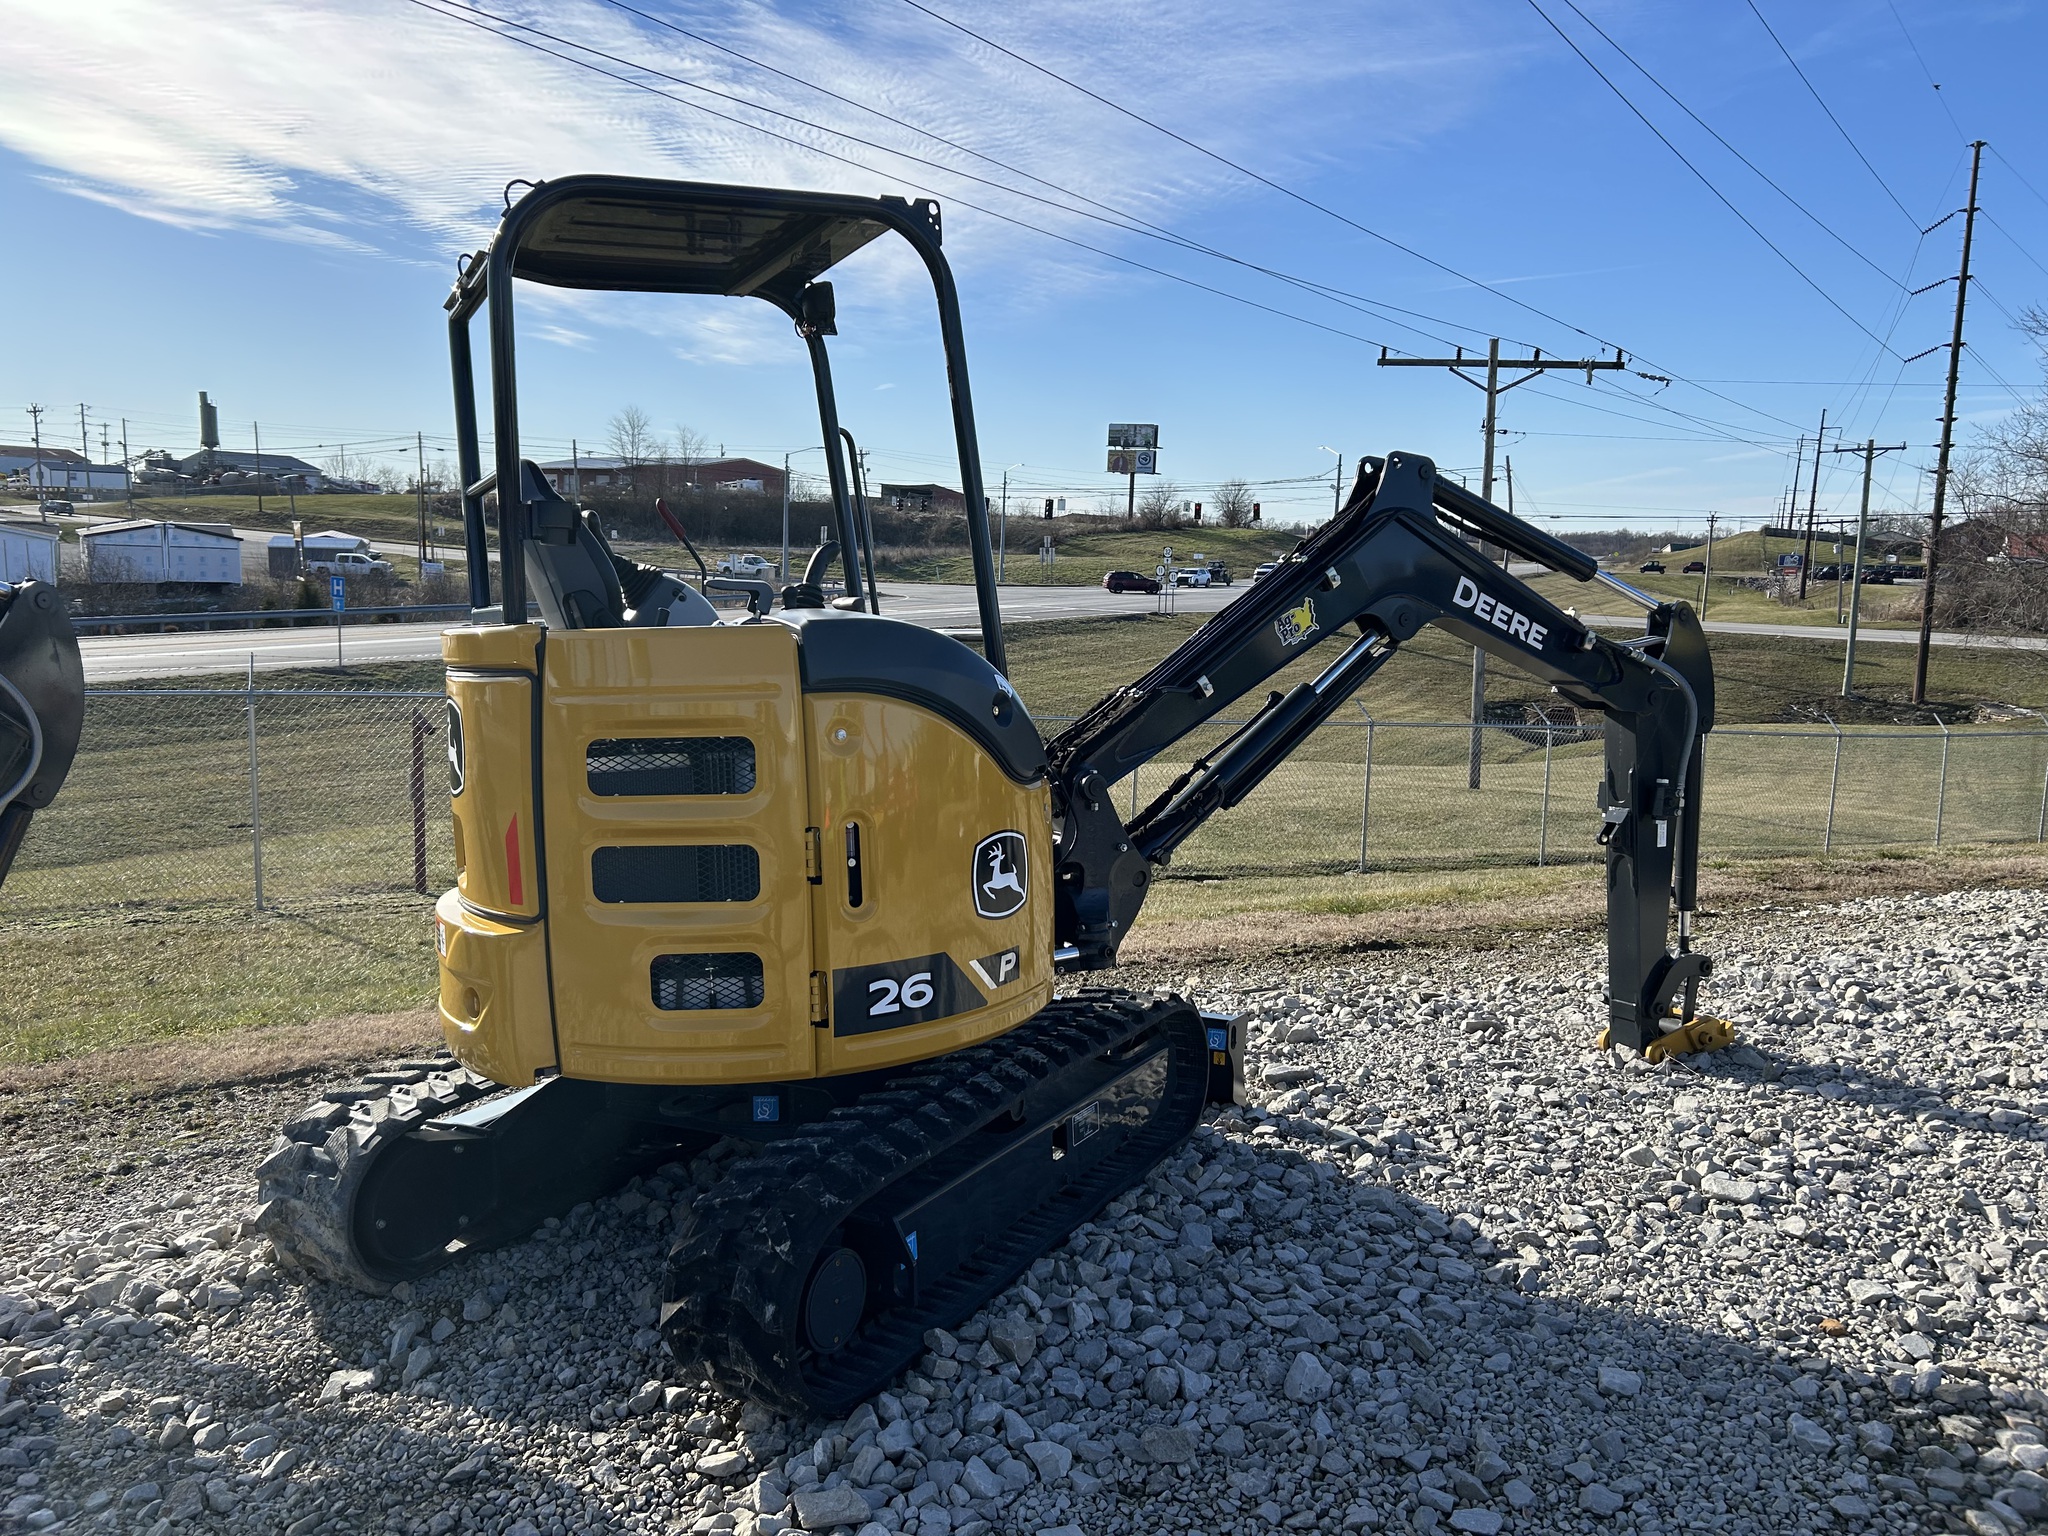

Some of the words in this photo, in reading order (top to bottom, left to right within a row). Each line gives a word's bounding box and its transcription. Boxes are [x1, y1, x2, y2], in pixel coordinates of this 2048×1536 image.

[333, 579, 343, 596] H
[1277, 613, 1295, 631] Ag-
[1452, 575, 1549, 651] DEERE
[1280, 623, 1300, 641] Pro
[869, 972, 934, 1016] 26
